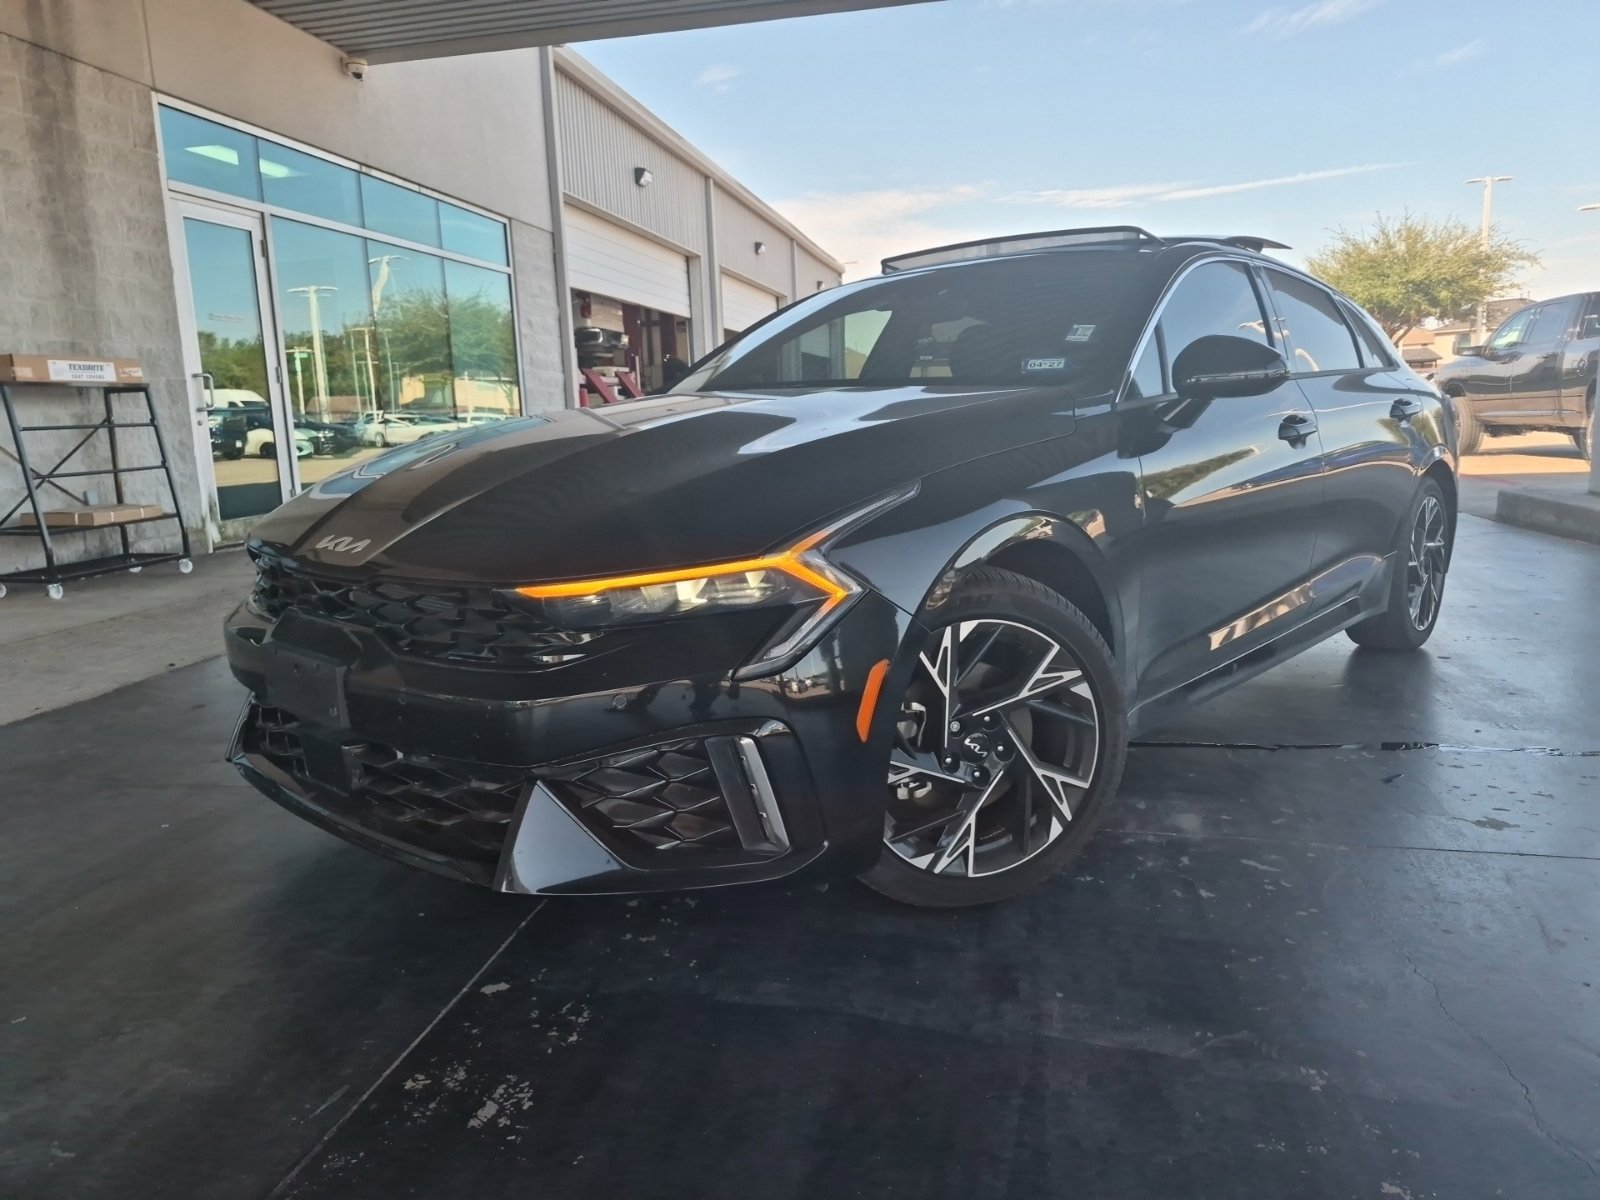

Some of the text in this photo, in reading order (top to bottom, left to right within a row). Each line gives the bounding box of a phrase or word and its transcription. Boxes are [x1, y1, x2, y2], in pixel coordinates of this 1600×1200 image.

[68, 363, 105, 372] TEXBRITE
[315, 534, 372, 554] KIA
[963, 738, 988, 758] KIA
